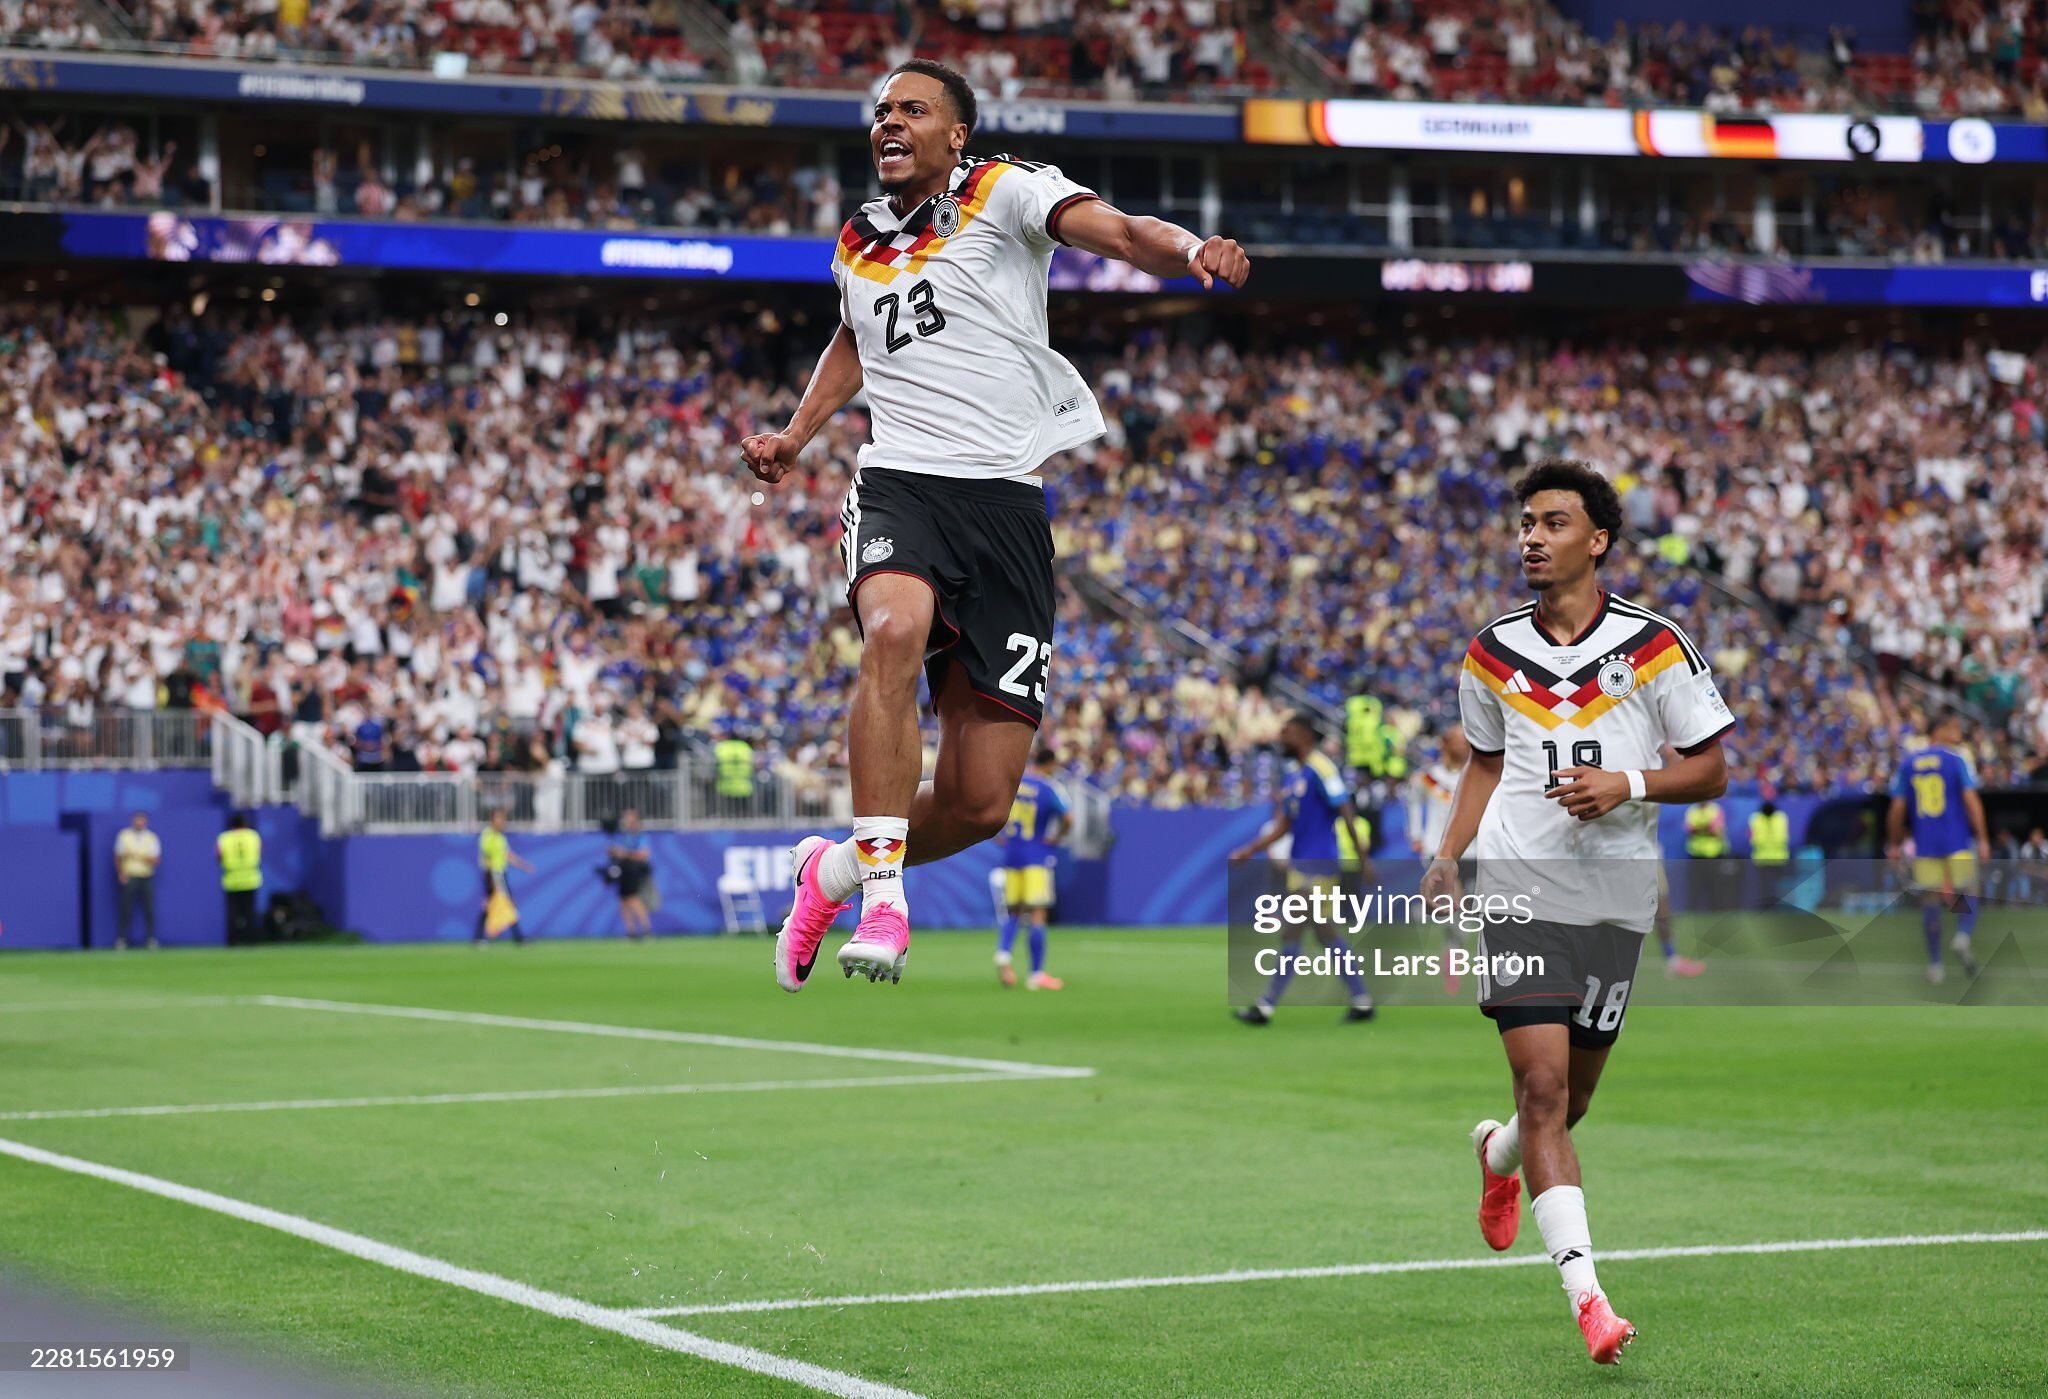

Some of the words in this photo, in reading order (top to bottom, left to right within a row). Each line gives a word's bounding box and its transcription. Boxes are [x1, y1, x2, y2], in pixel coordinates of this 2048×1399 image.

[873, 278, 947, 355] 23
[998, 632, 1053, 704] 23
[1572, 974, 1630, 1031] 18
